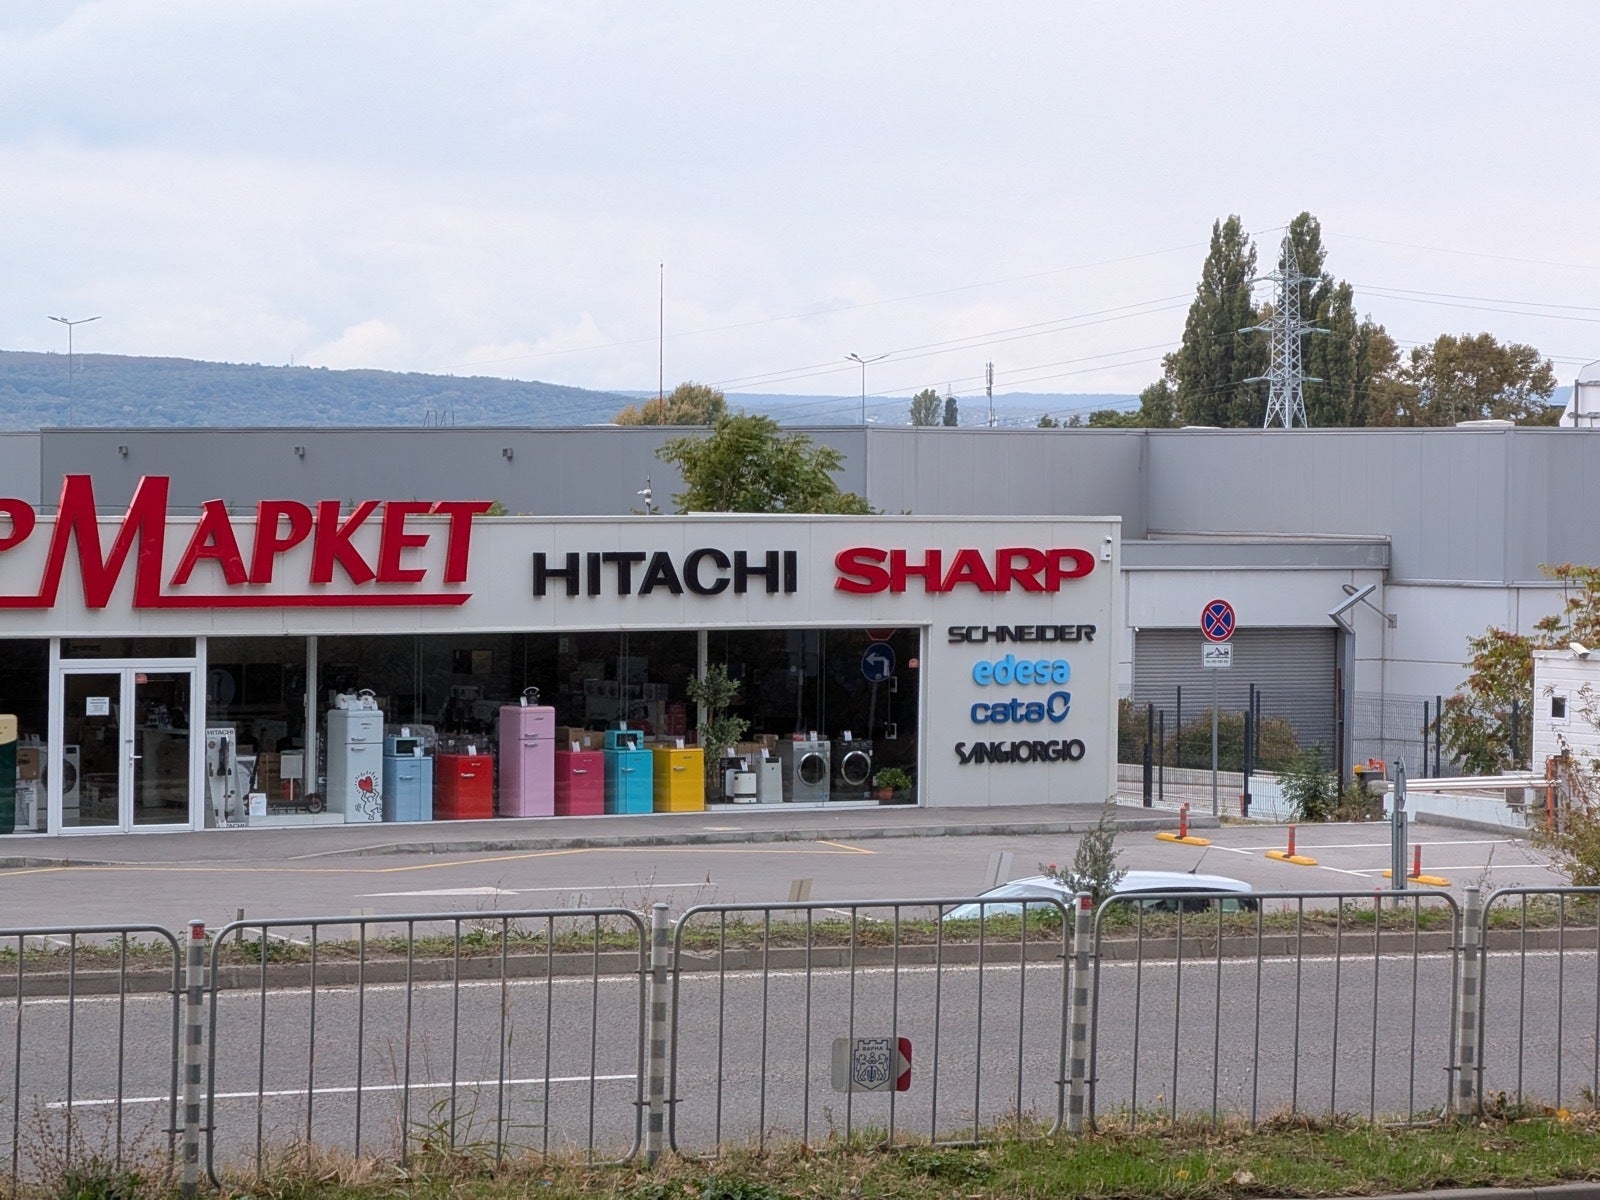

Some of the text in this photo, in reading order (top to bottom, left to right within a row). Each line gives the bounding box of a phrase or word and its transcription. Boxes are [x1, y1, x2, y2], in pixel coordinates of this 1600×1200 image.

[532, 548, 798, 597] HITACHI
[834, 547, 1096, 594] SHARP
[948, 624, 1097, 643] SCHNEIDER
[972, 653, 1071, 686] edesa
[954, 738, 1086, 765] SANGIORGIO
